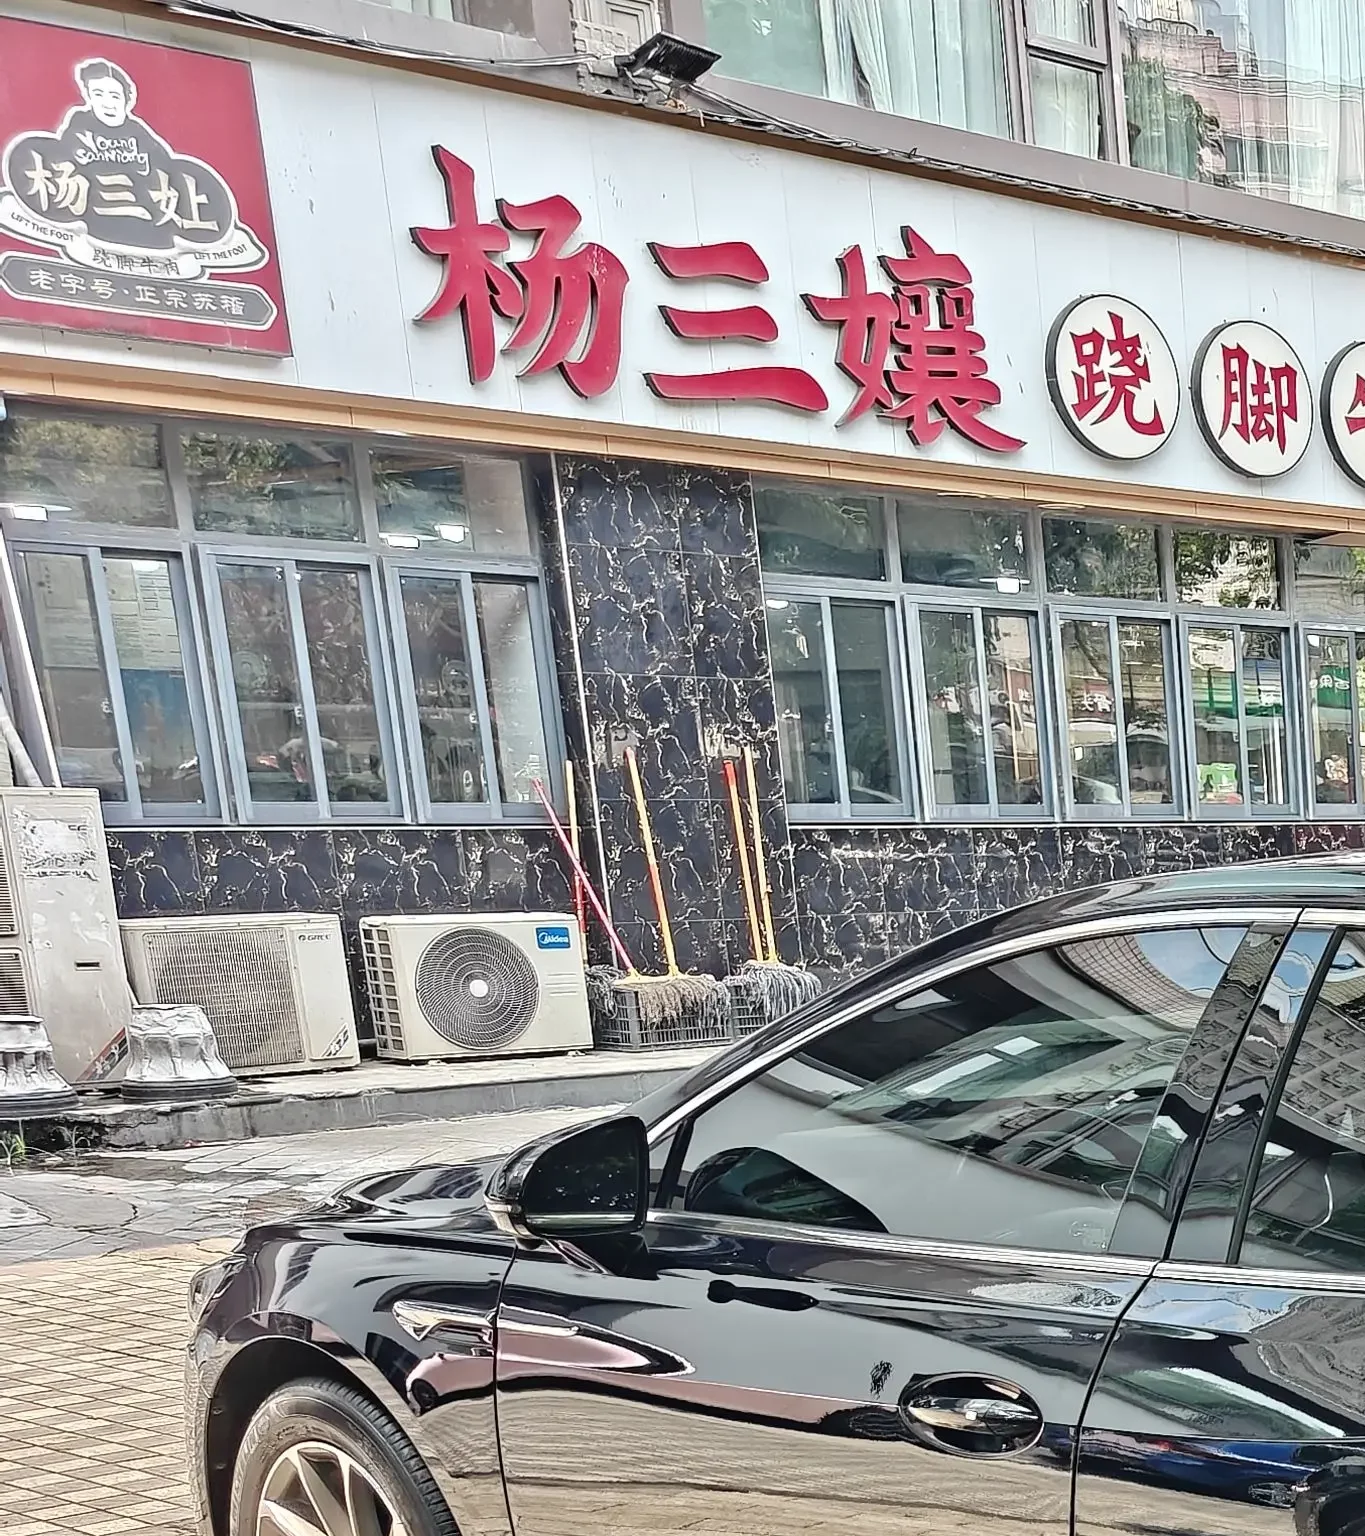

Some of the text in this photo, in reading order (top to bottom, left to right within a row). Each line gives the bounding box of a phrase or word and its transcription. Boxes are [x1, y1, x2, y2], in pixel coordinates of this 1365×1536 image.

[75, 130, 138, 150] Young
[31, 222, 50, 235] THE
[50, 228, 74, 243] FOOT
[212, 250, 227, 259] THE
[227, 243, 248, 258] FOOT
